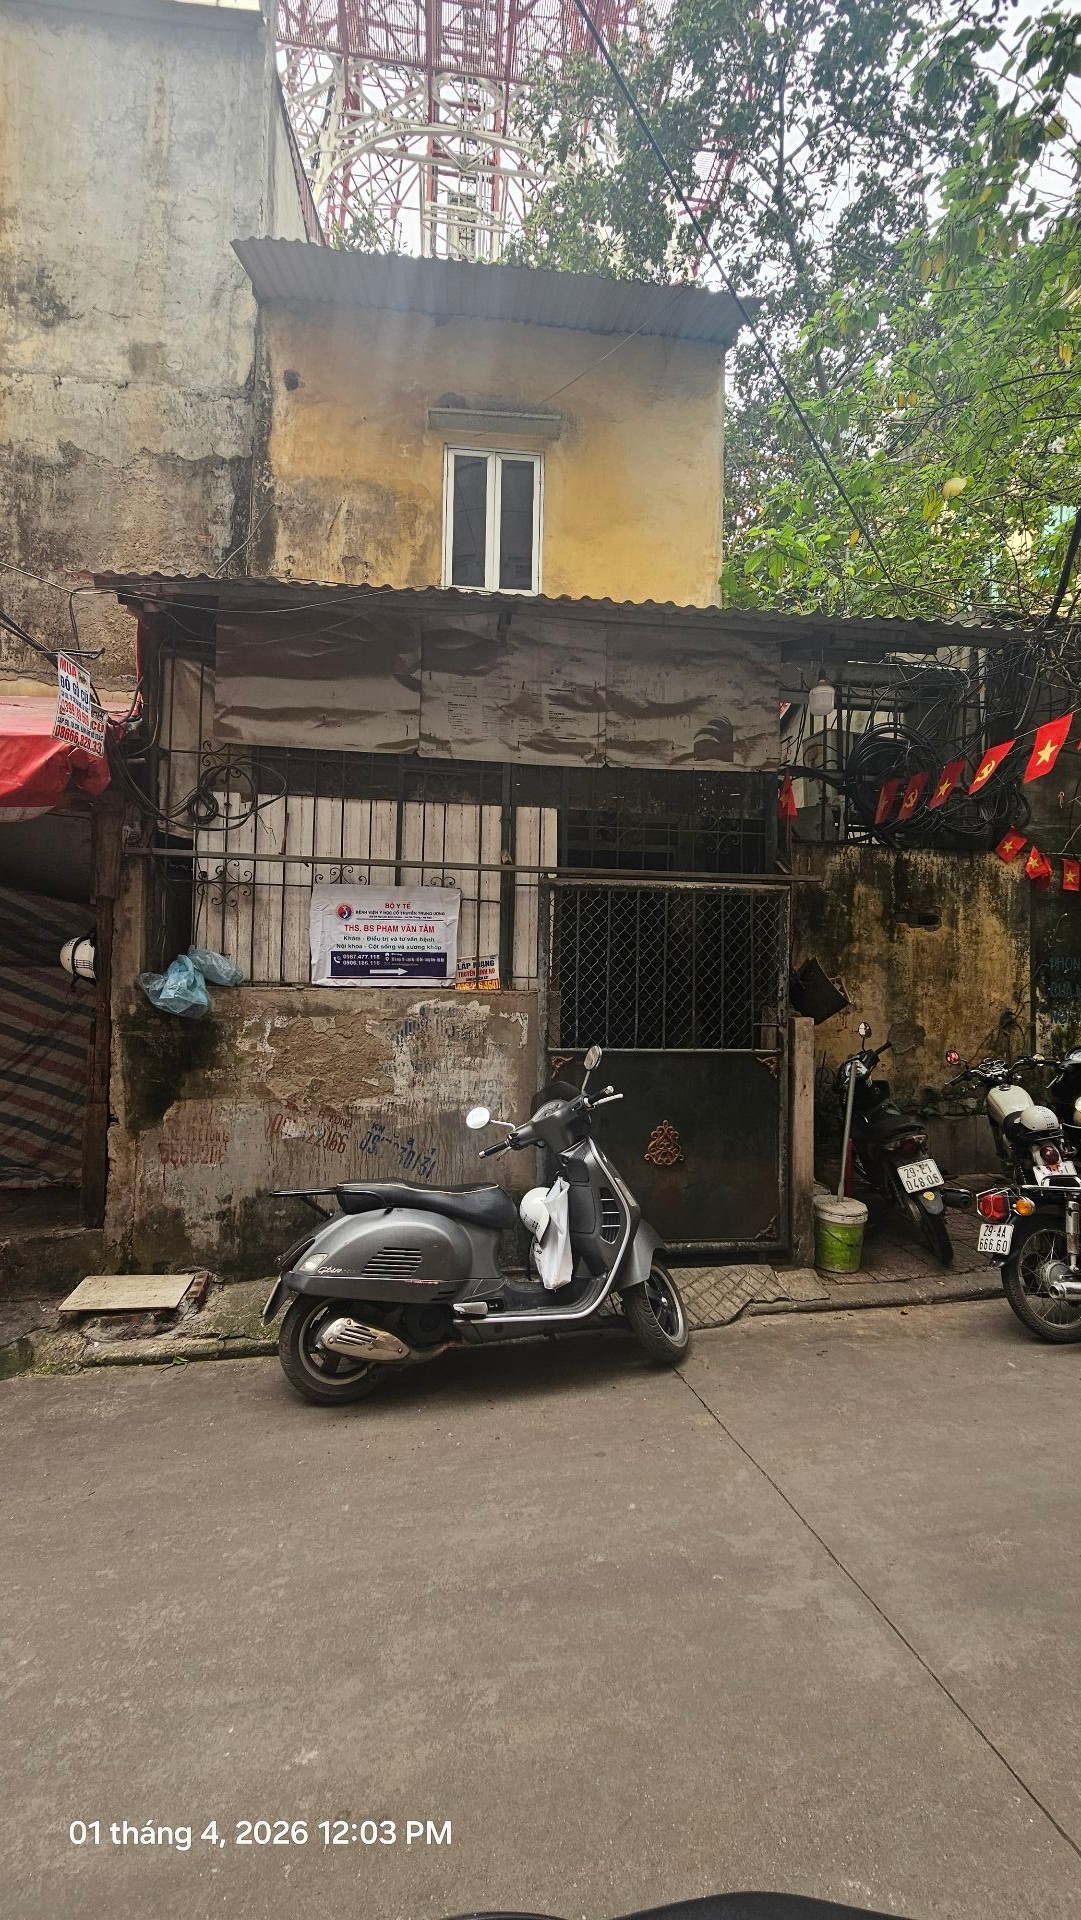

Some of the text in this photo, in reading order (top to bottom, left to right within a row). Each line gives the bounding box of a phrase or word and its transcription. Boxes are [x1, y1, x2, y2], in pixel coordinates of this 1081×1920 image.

[59, 656, 79, 679] MUA
[402, 901, 411, 909] TẾ
[344, 924, 362, 932] THS.
[363, 924, 375, 932] BS
[376, 925, 399, 934] PHẠM
[401, 923, 417, 933] VĂN
[903, 1163, 932, 1179] 29-E1
[905, 1173, 941, 1191] 048.06
[983, 1224, 1007, 1239] 29-AA
[979, 1238, 1008, 1252] 666.60
